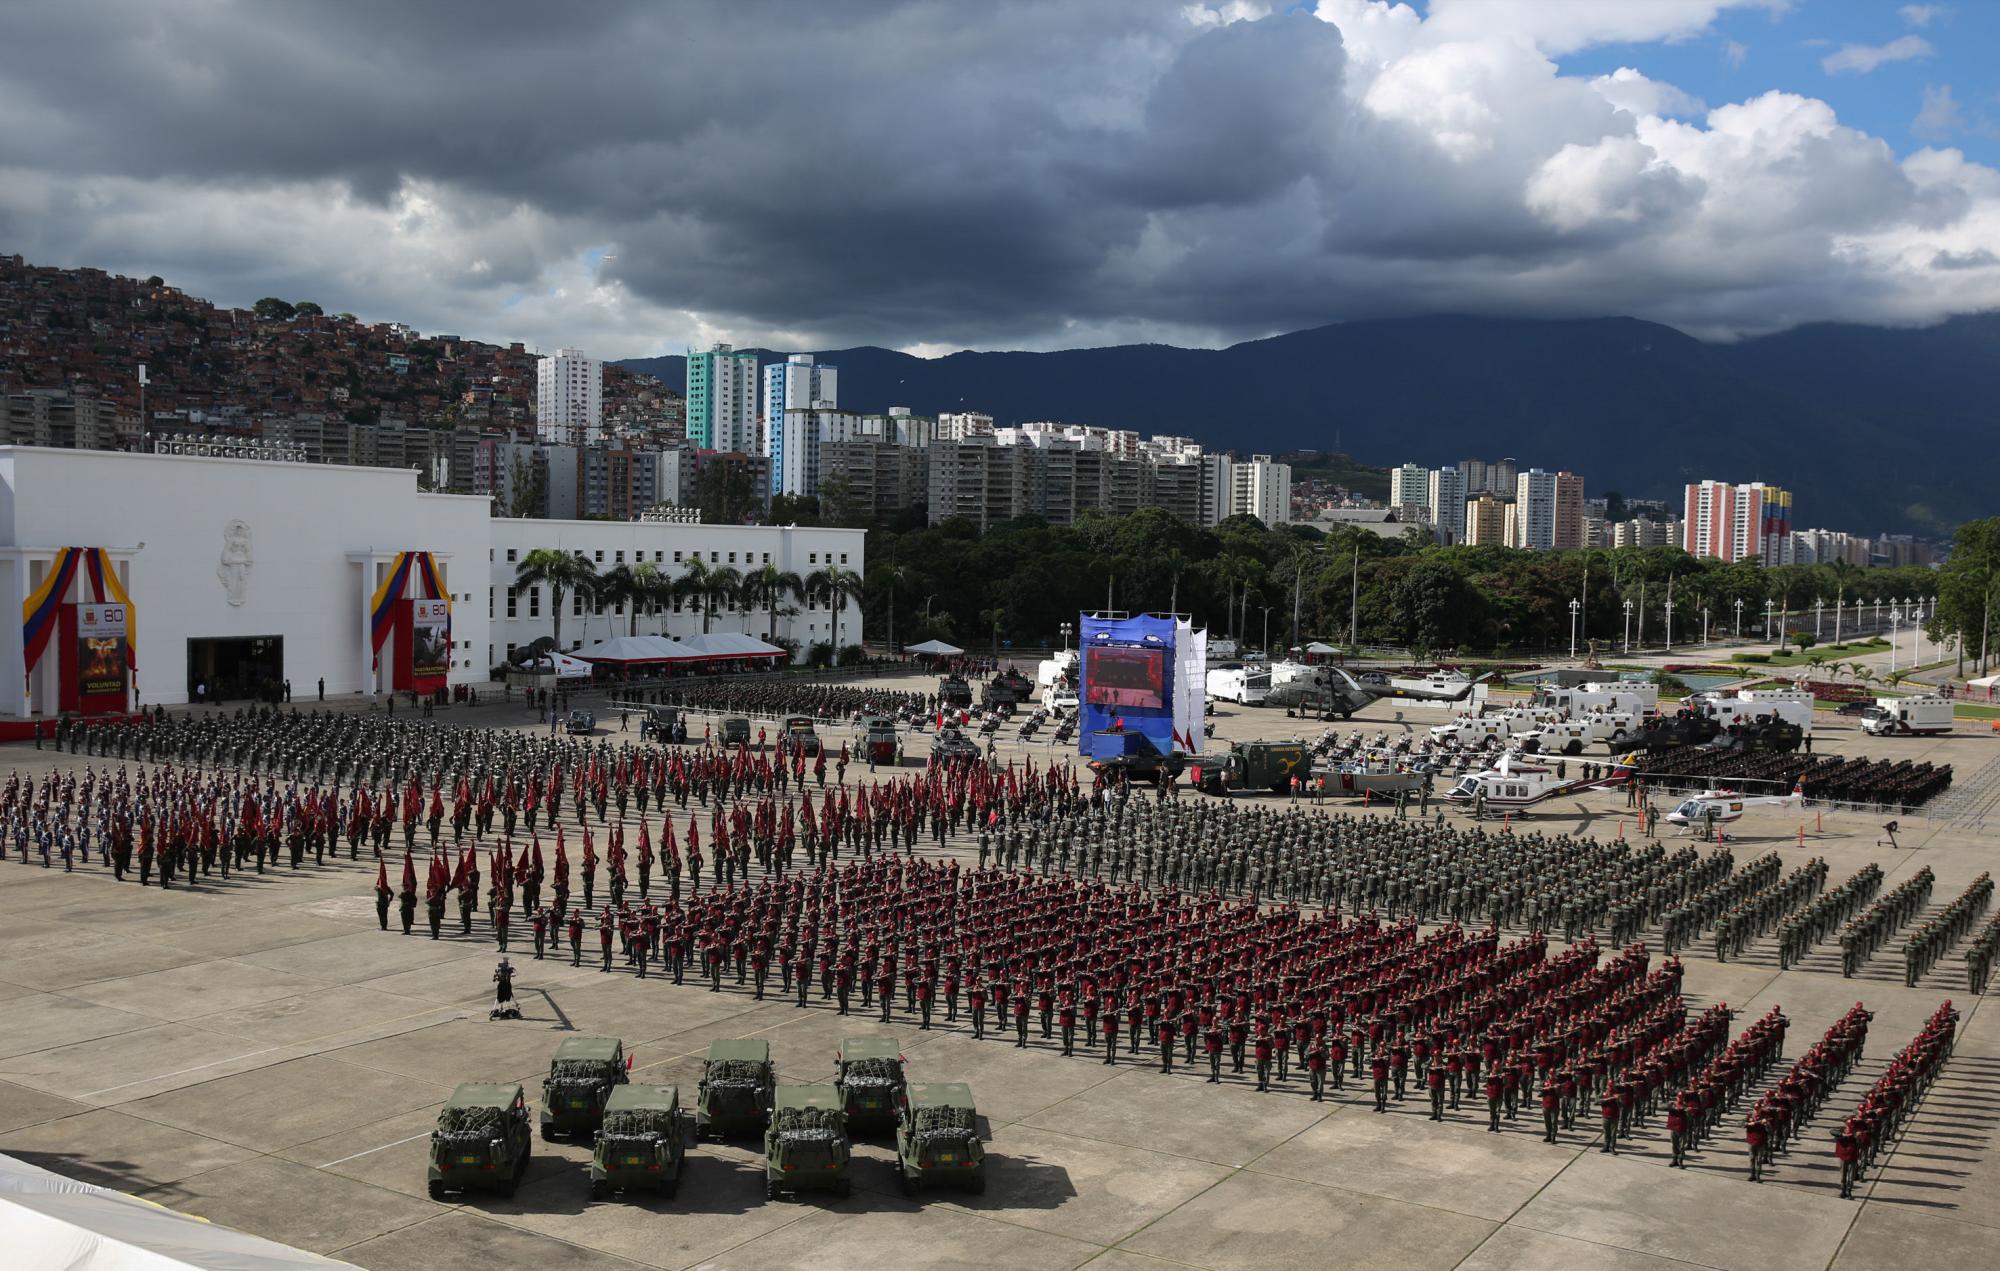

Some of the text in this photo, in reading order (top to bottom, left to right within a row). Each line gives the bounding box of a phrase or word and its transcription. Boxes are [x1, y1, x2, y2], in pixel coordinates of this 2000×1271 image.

[104, 609, 123, 622] 80
[432, 604, 446, 616] 80
[87, 681, 121, 689] VOLUNTAD
